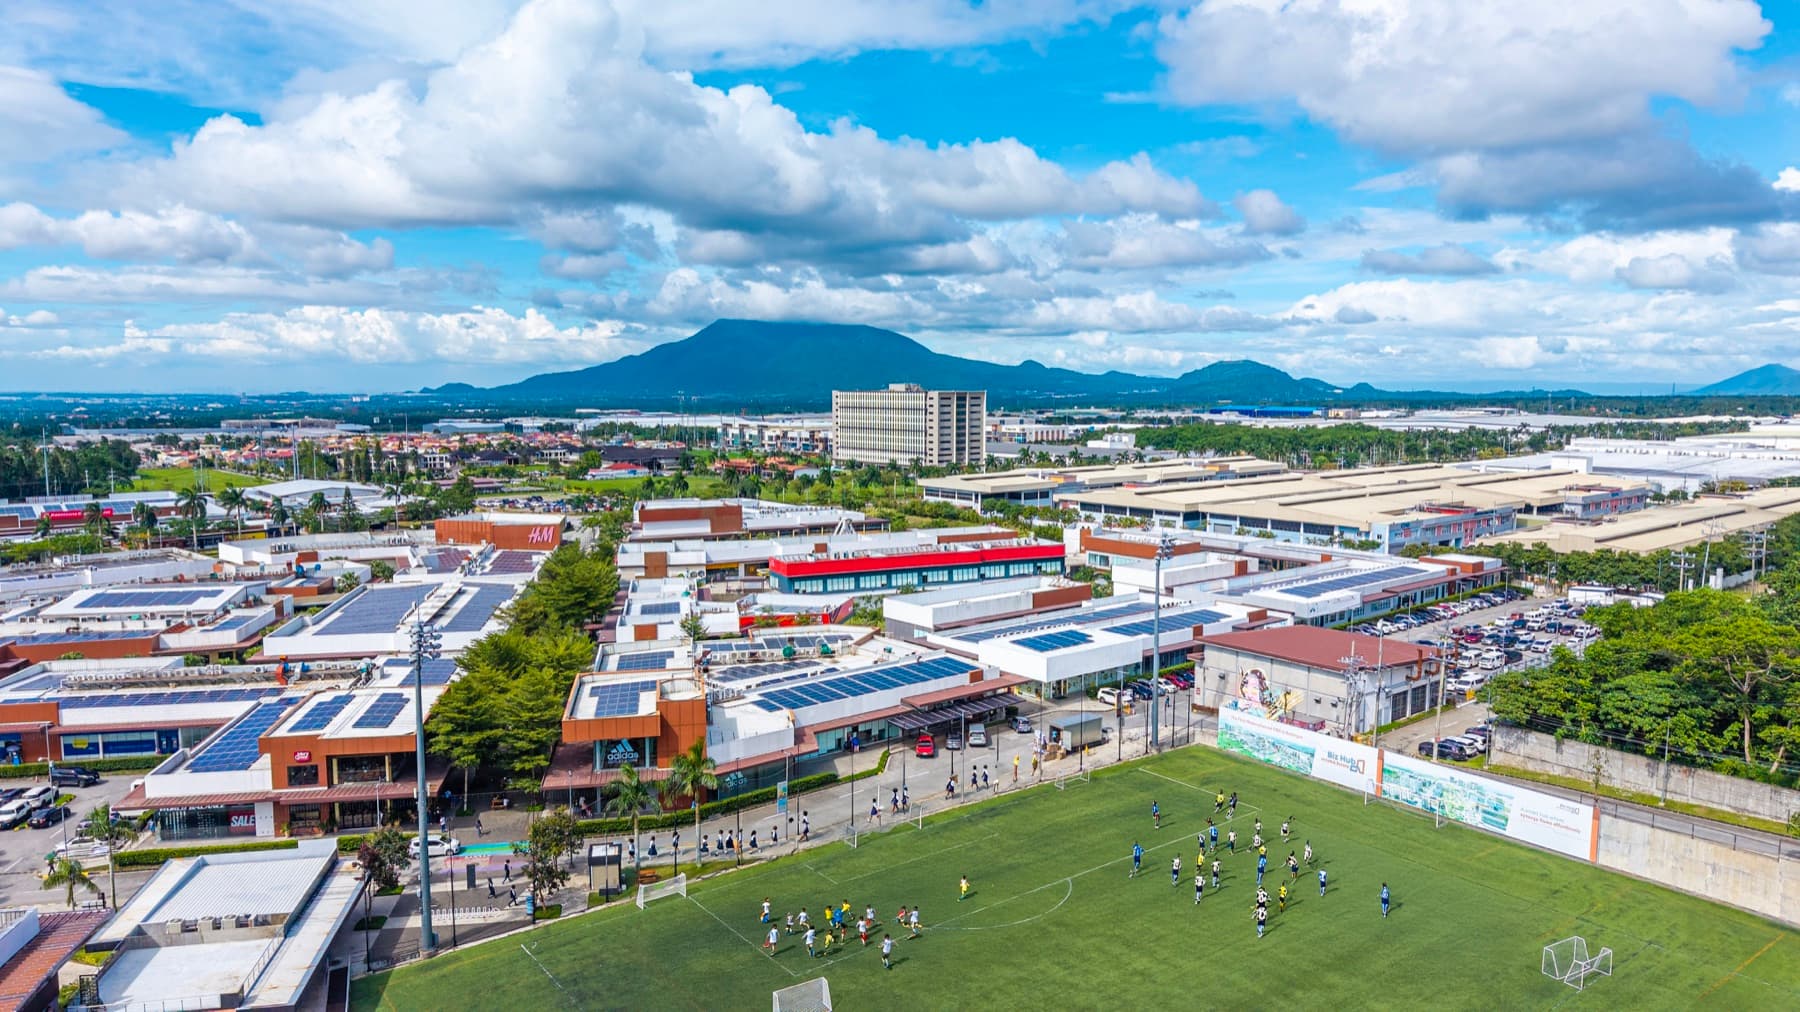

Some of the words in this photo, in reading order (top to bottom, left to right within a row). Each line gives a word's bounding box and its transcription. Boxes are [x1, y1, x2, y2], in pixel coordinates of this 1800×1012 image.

[528, 526, 554, 544] H&M
[607, 751, 639, 760] adidas
[1327, 751, 1339, 760] Biz
[1340, 754, 1356, 765] Hub
[231, 815, 255, 827] SALE
